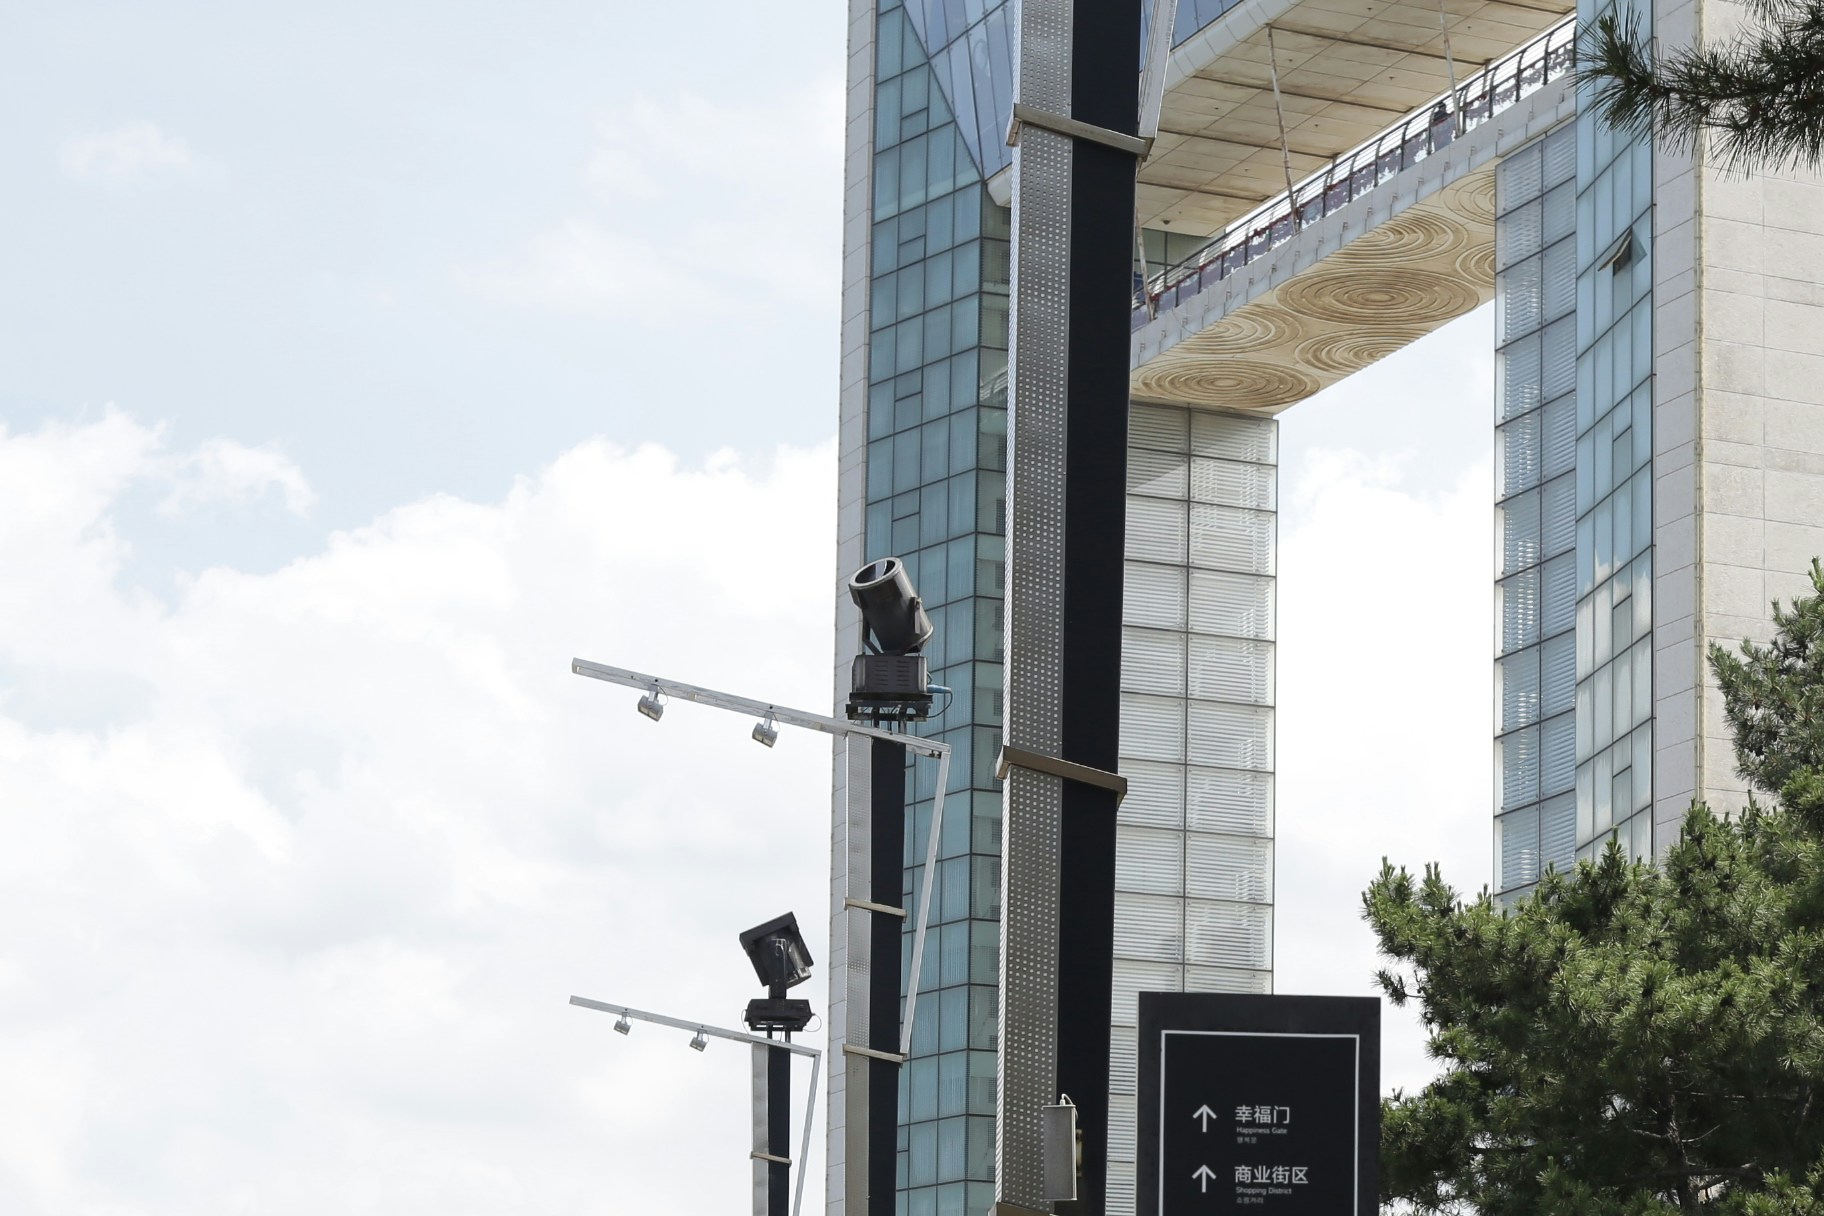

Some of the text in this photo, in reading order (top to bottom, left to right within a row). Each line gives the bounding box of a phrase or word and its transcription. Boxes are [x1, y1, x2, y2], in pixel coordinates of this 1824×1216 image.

[1235, 1104, 1290, 1124] 幸福门
[1236, 1127, 1270, 1135] Happiness
[1234, 1164, 1309, 1184] 商业街区
[1235, 1187, 1292, 1196] Shopping District
